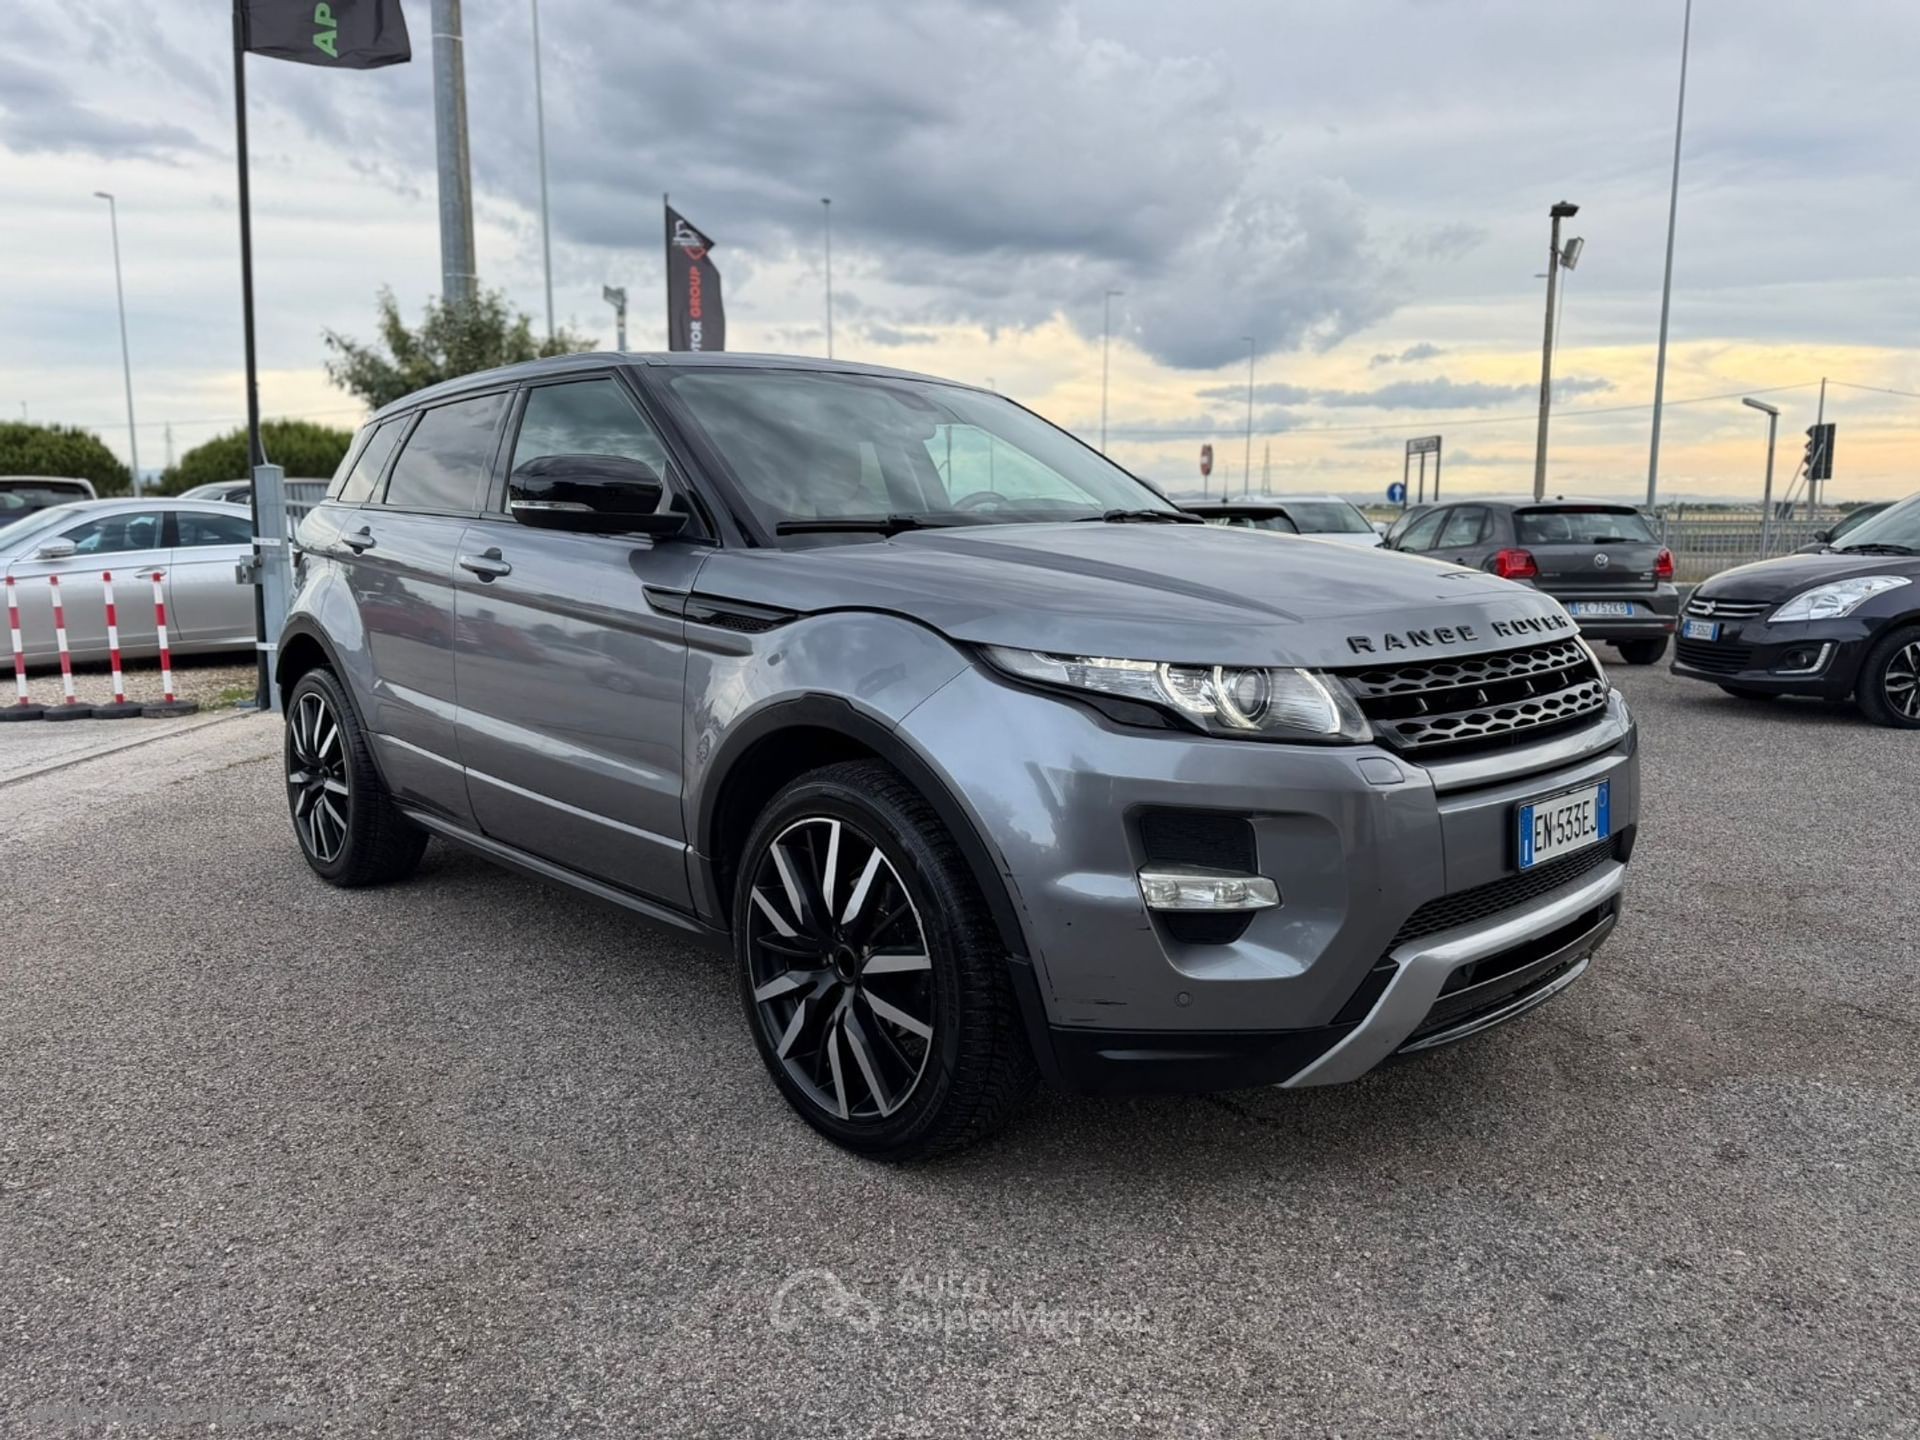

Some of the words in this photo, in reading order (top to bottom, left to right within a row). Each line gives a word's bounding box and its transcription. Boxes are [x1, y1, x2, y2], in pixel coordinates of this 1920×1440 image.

[313, 2, 338, 58] AP
[689, 266, 702, 319] GROUP
[690, 321, 702, 351] TOR
[1347, 625, 1479, 654] RANGE
[1491, 615, 1568, 637] ROVER
